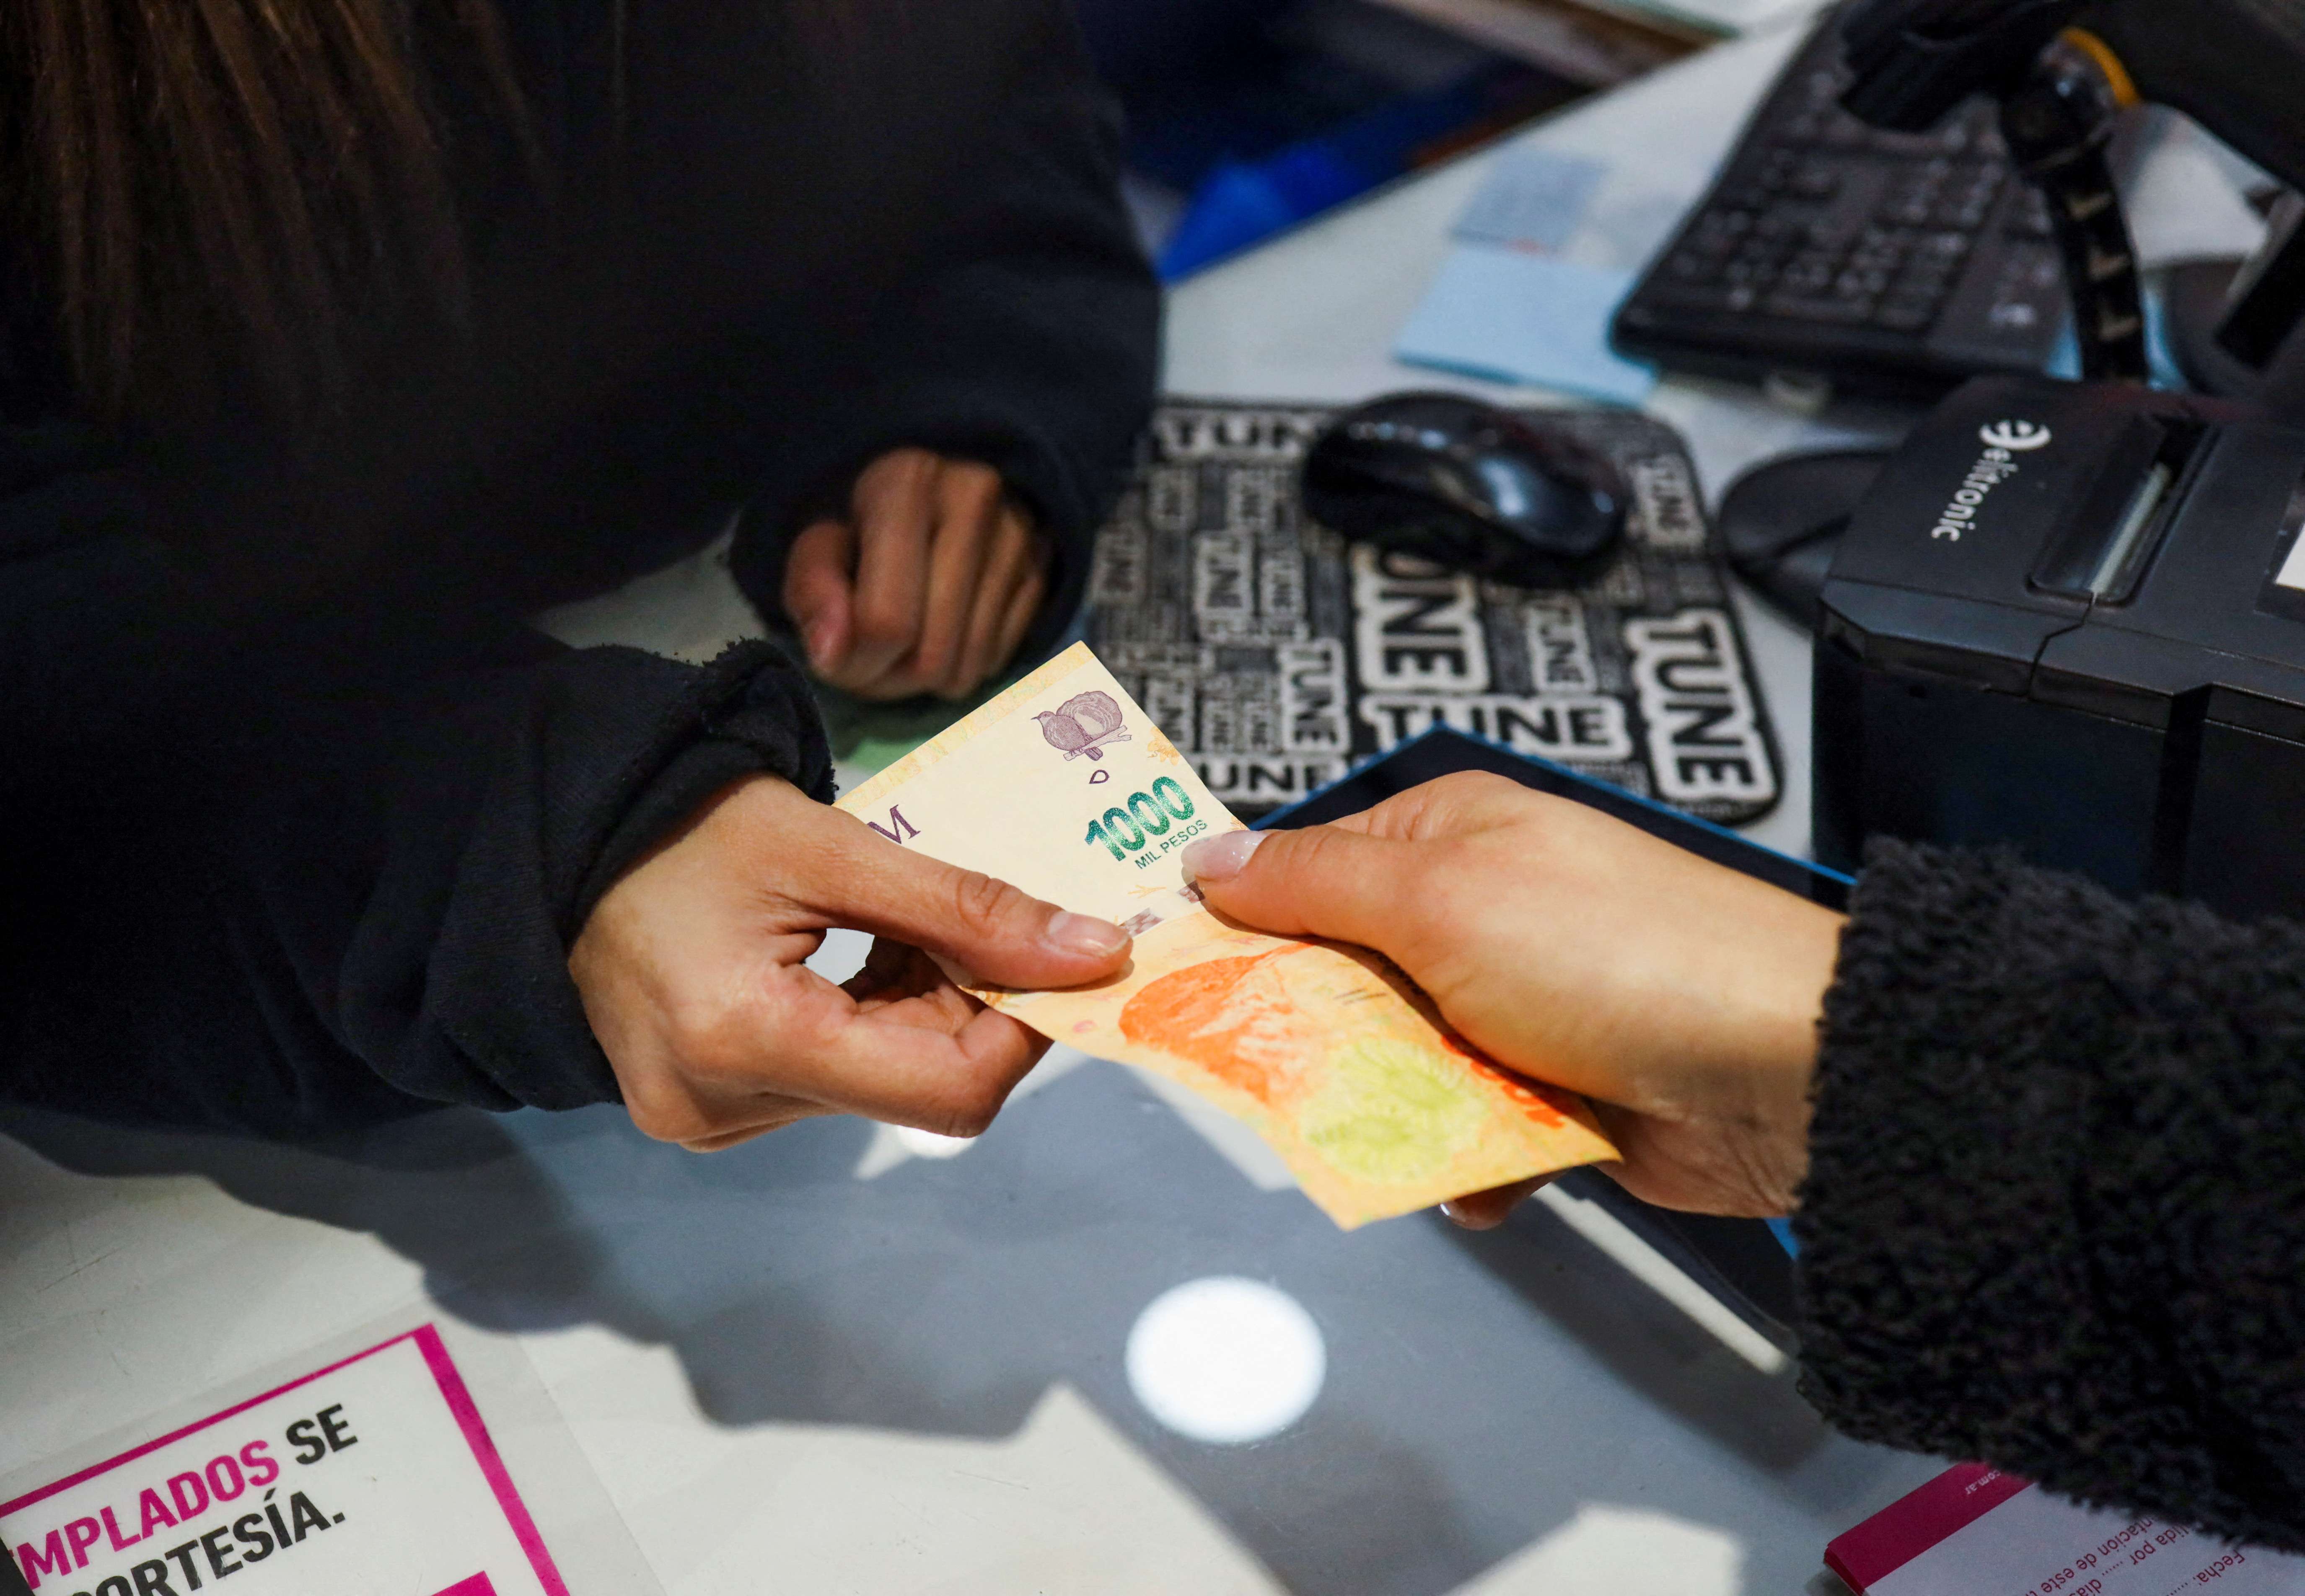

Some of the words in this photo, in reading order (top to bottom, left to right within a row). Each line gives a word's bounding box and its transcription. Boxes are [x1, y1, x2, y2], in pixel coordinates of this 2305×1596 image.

[1168, 416, 1310, 448] TUN
[1378, 551, 1467, 677] UNE
[1292, 647, 1338, 745] TUNE
[1648, 621, 1754, 784] TUNE
[1199, 763, 1329, 792] UNE
[867, 804, 921, 844] M
[1084, 776, 1194, 861] 1000
[1134, 851, 1162, 869] MIL
[1159, 819, 1208, 854] PESOS
[9, 1440, 280, 1589] MPLADOS
[286, 1403, 358, 1465] SE
[1965, 1469, 2002, 1495] com.ar
[72, 1487, 345, 1596] RTESÍA.
[2097, 1517, 2155, 1556] ntación
[2129, 1540, 2157, 1565] por
[2155, 1524, 2190, 1544] lida
[2076, 1553, 2097, 1568] de
[2192, 1549, 2246, 1586] Fecha:
[2041, 1568, 2075, 1593] este
